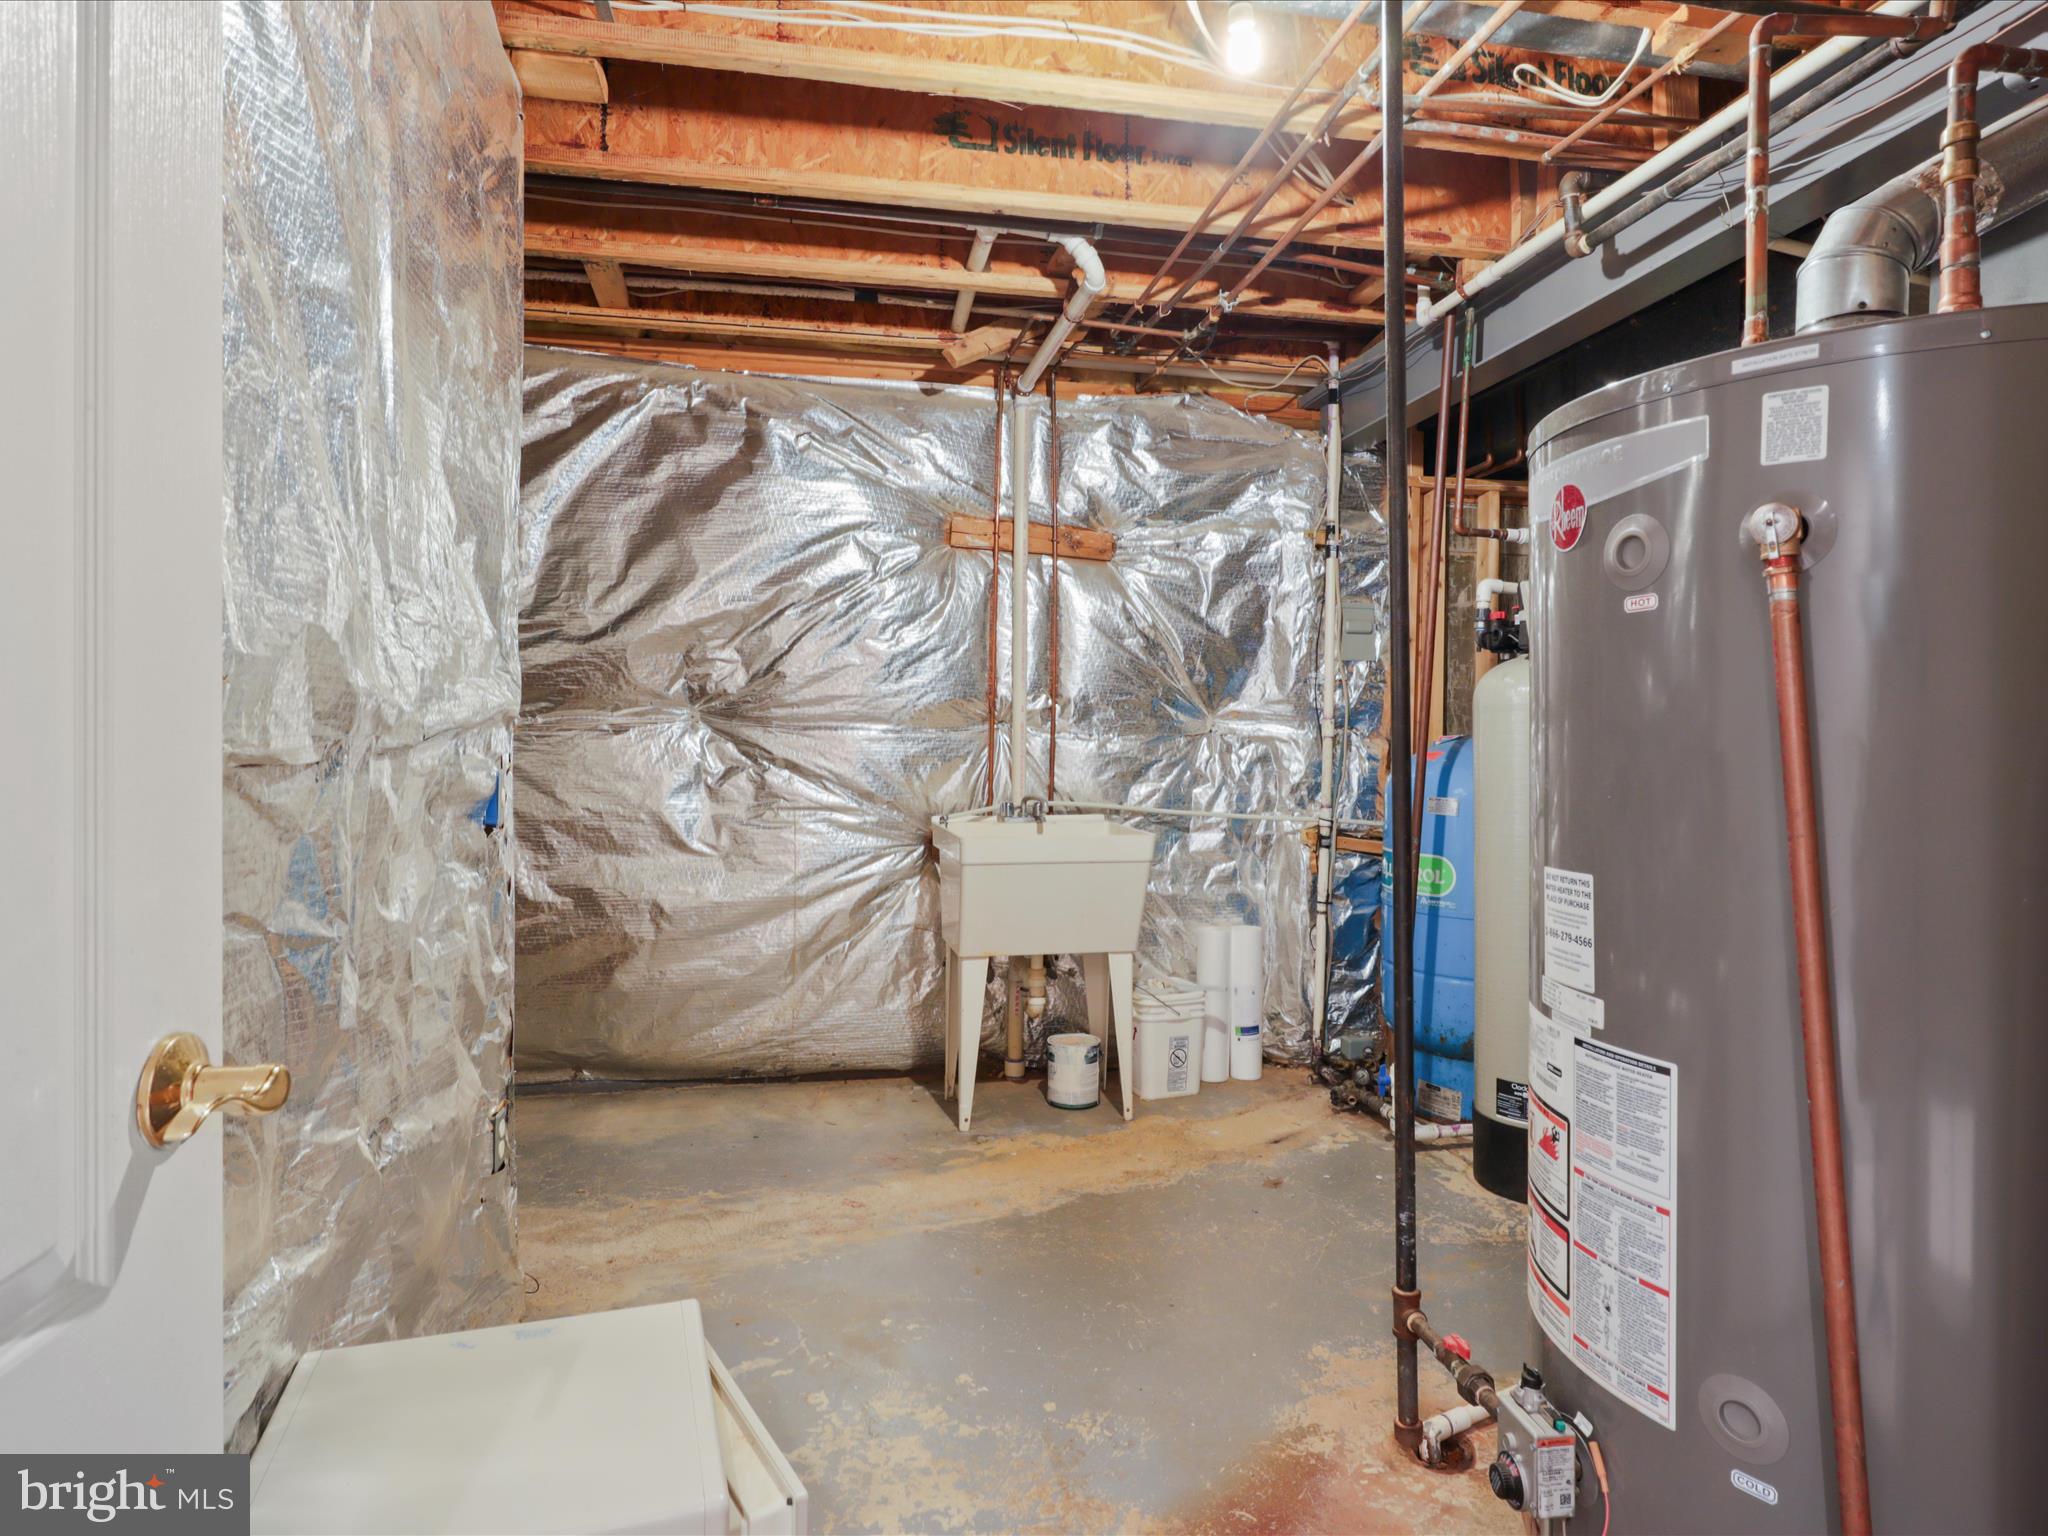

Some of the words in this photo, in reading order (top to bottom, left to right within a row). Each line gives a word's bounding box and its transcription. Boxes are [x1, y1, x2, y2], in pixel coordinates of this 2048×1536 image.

[1003, 120, 1077, 161] Silent
[1551, 489, 1586, 542] Rheem
[1629, 596, 1653, 608] HOT
[1560, 876, 1577, 886] RETURN
[1579, 879, 1590, 888] THIS
[1574, 889, 1580, 897] TO
[1581, 891, 1592, 899] THE
[1564, 898, 1590, 910] PURCHASE
[1736, 1475, 1771, 1498] COLD
